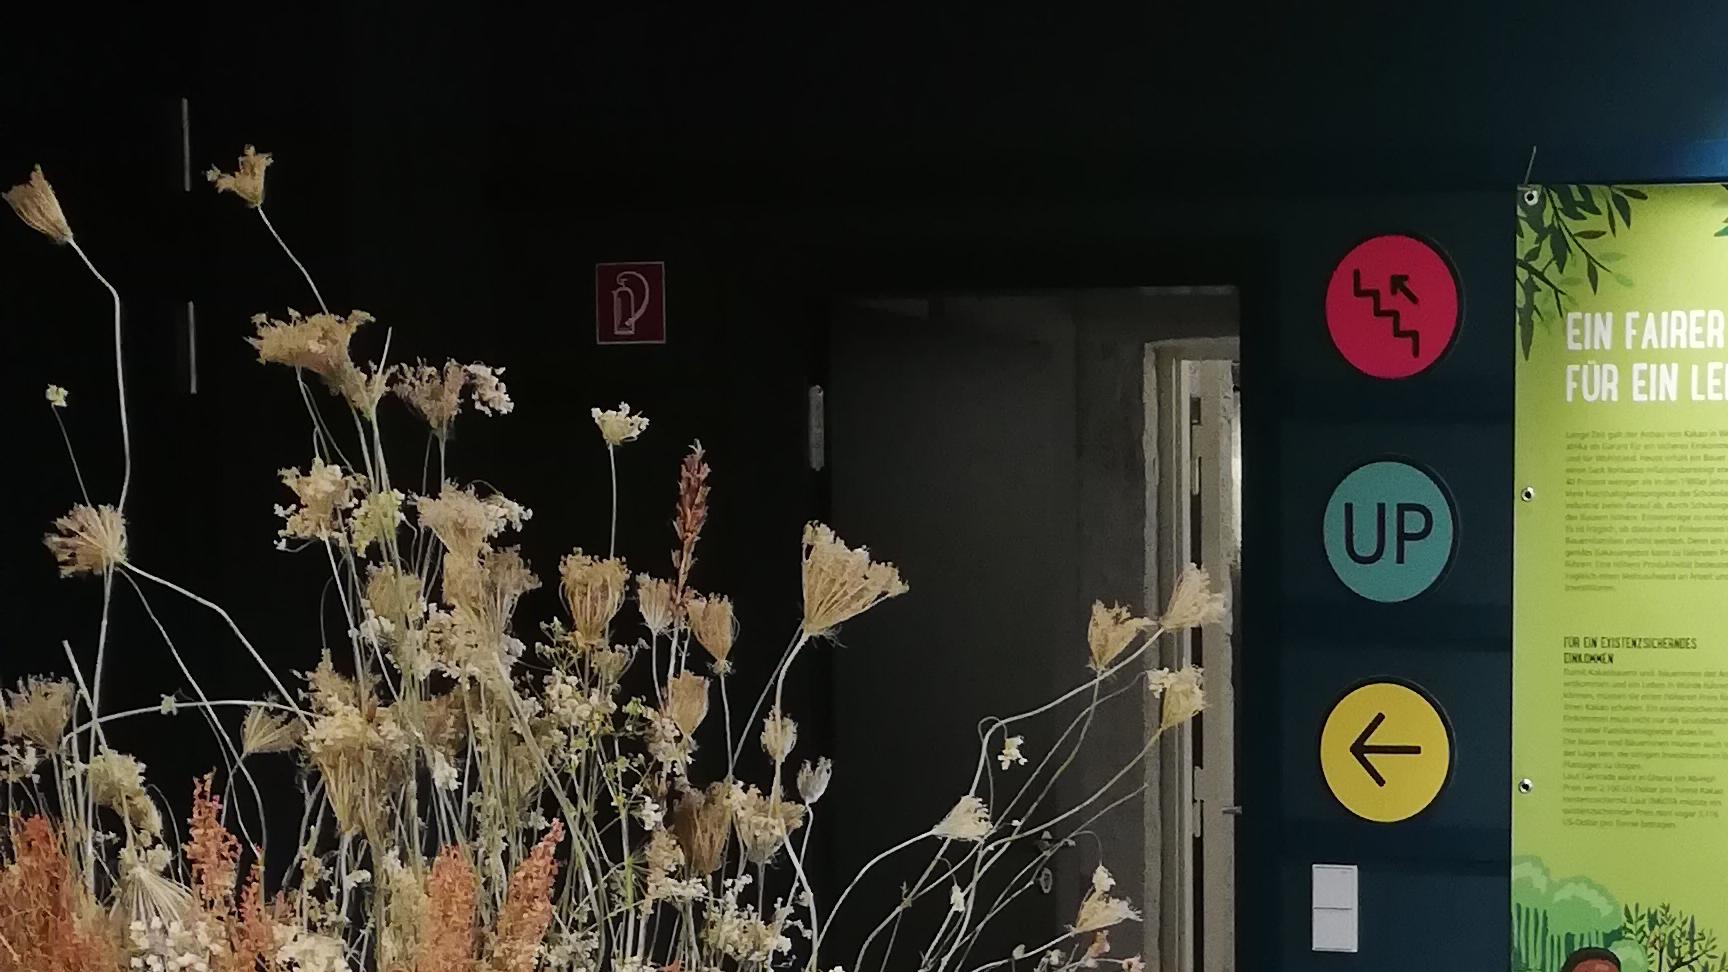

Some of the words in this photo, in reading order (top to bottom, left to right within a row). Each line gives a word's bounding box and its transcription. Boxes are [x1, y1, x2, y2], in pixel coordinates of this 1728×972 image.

[1566, 311, 1614, 351] EIN
[1624, 309, 1725, 350] FAIRER
[1565, 360, 1619, 403] FÜR
[1632, 362, 1679, 402] EIN
[1343, 501, 1434, 565] UP
